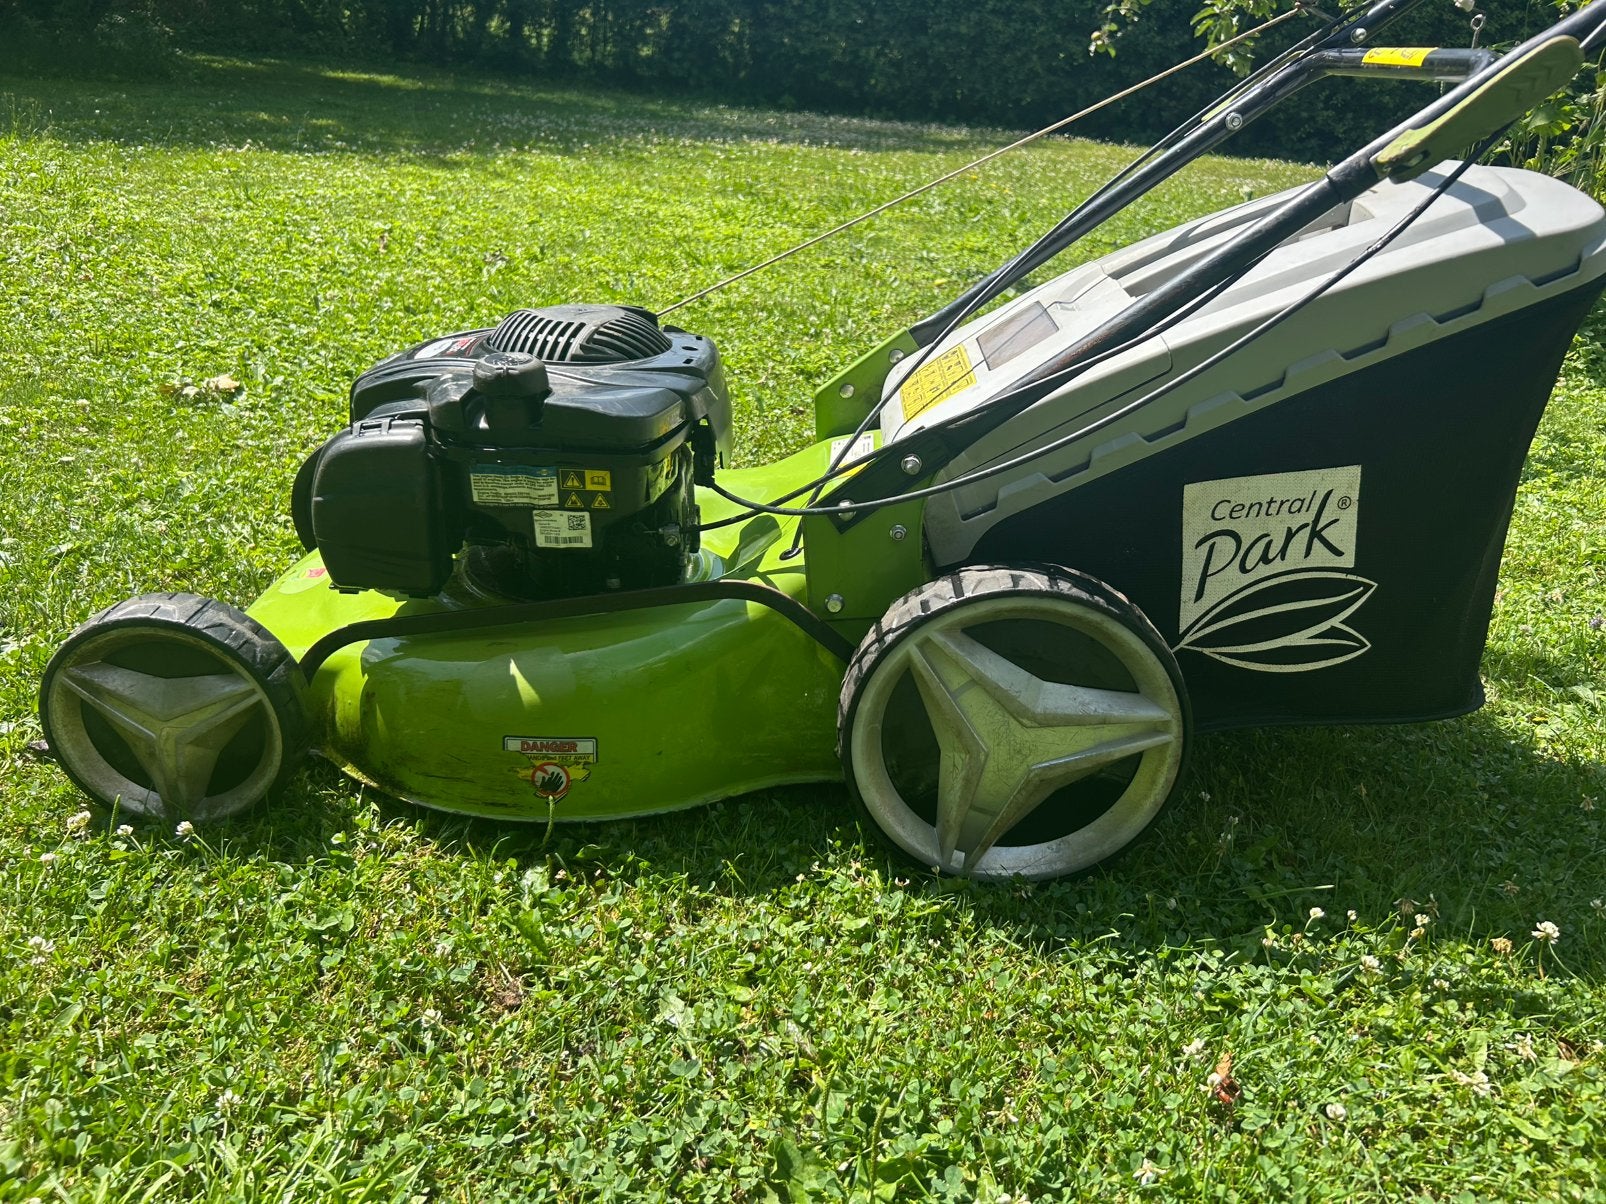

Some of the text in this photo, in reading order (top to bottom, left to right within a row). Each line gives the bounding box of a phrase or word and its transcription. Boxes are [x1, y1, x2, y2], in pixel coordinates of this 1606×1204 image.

[1211, 490, 1317, 521] Central
[1194, 488, 1345, 604] Park
[520, 741, 577, 752] DANGER
